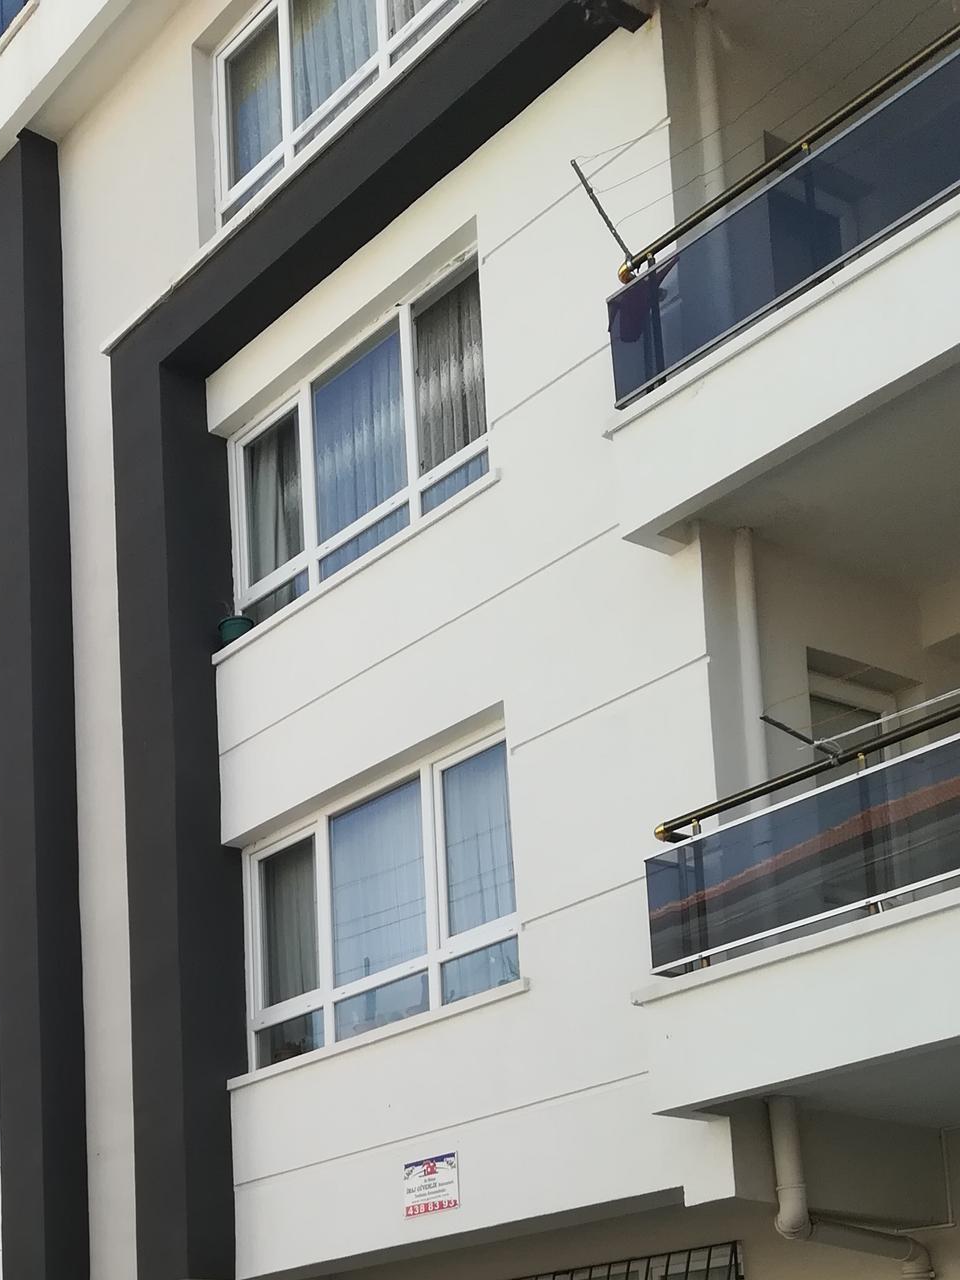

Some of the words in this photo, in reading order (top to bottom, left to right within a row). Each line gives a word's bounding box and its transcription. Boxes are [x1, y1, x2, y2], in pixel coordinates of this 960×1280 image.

[407, 1204, 425, 1216] 438
[427, 1201, 440, 1211] 83
[442, 1199, 455, 1208] 93
